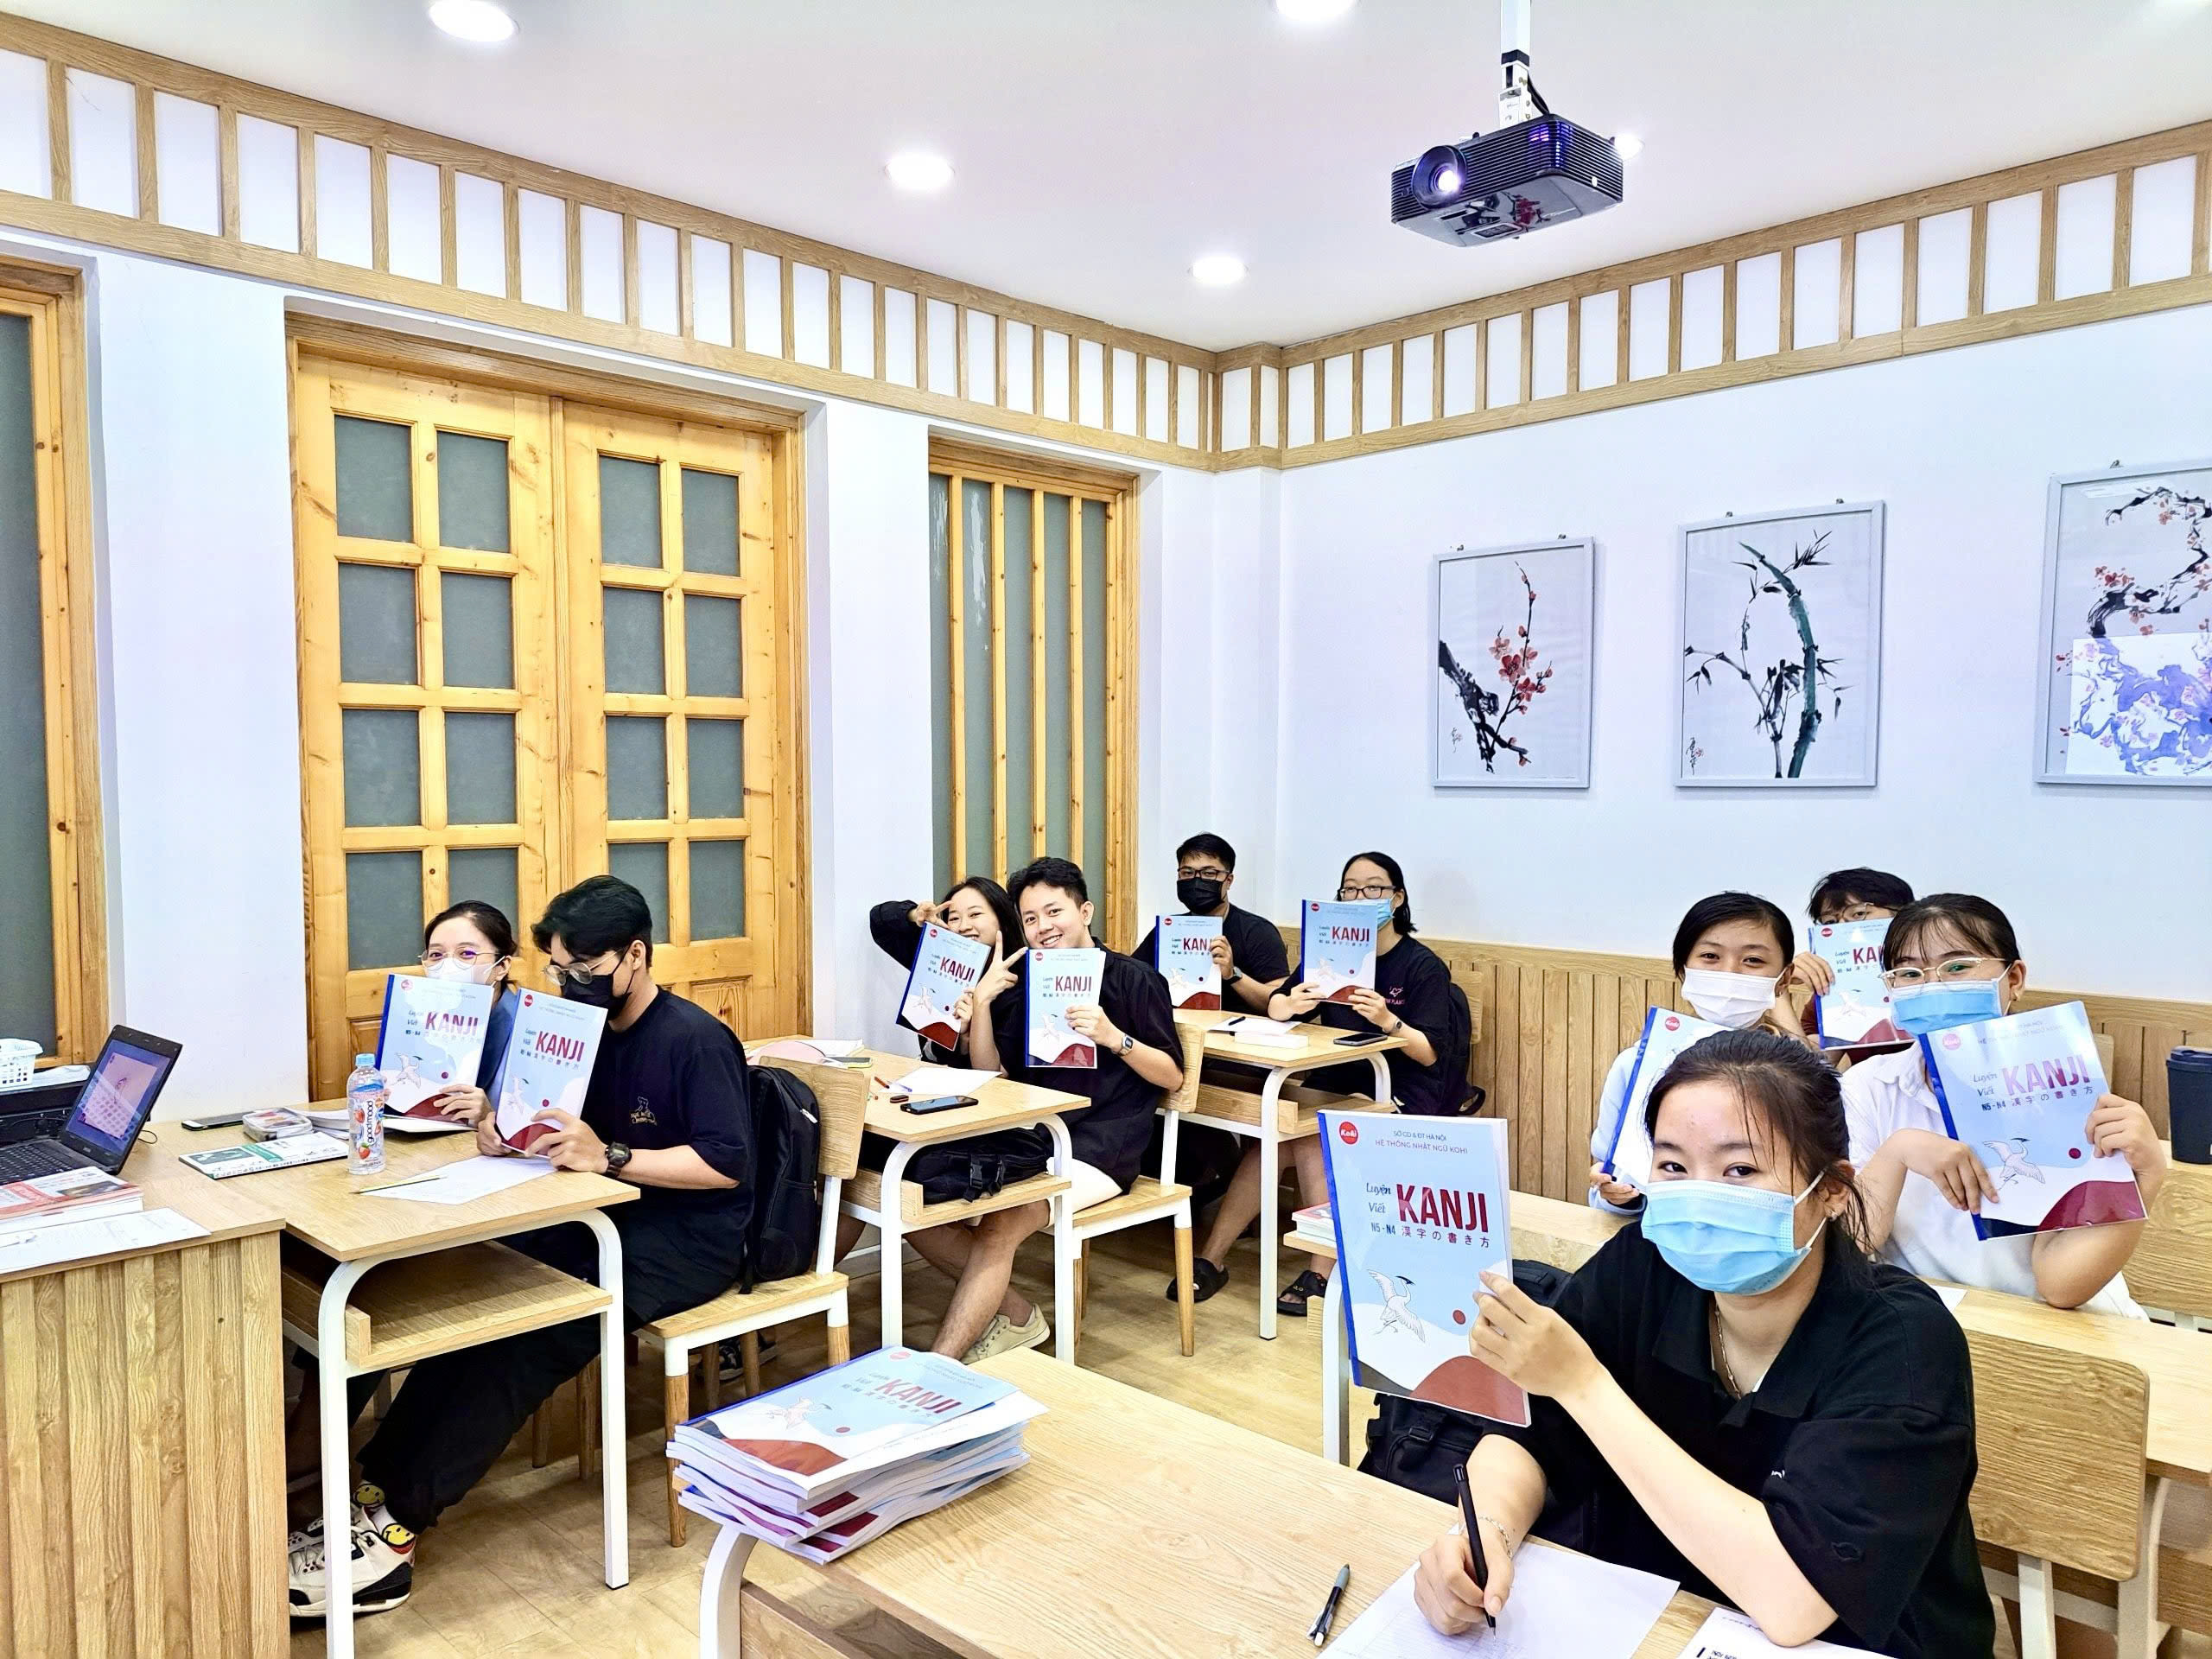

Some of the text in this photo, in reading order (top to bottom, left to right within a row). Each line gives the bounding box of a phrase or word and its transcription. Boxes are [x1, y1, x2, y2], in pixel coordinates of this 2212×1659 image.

[1183, 938, 1212, 952] KAN
[1332, 925, 1370, 942] KANJI
[939, 957, 976, 982] KANJI
[1055, 976, 1092, 992] KANJI
[424, 1011, 479, 1036] KANJI
[535, 1030, 585, 1062] KANJI
[2001, 1054, 2091, 1096] KANJI
[1395, 1183, 1489, 1233] KANJI
[1370, 1222, 1381, 1233] N5
[1386, 1224, 1396, 1235] N4
[1402, 1225, 1491, 1249] 漢字の書き方
[874, 1378, 963, 1414] KANJI
